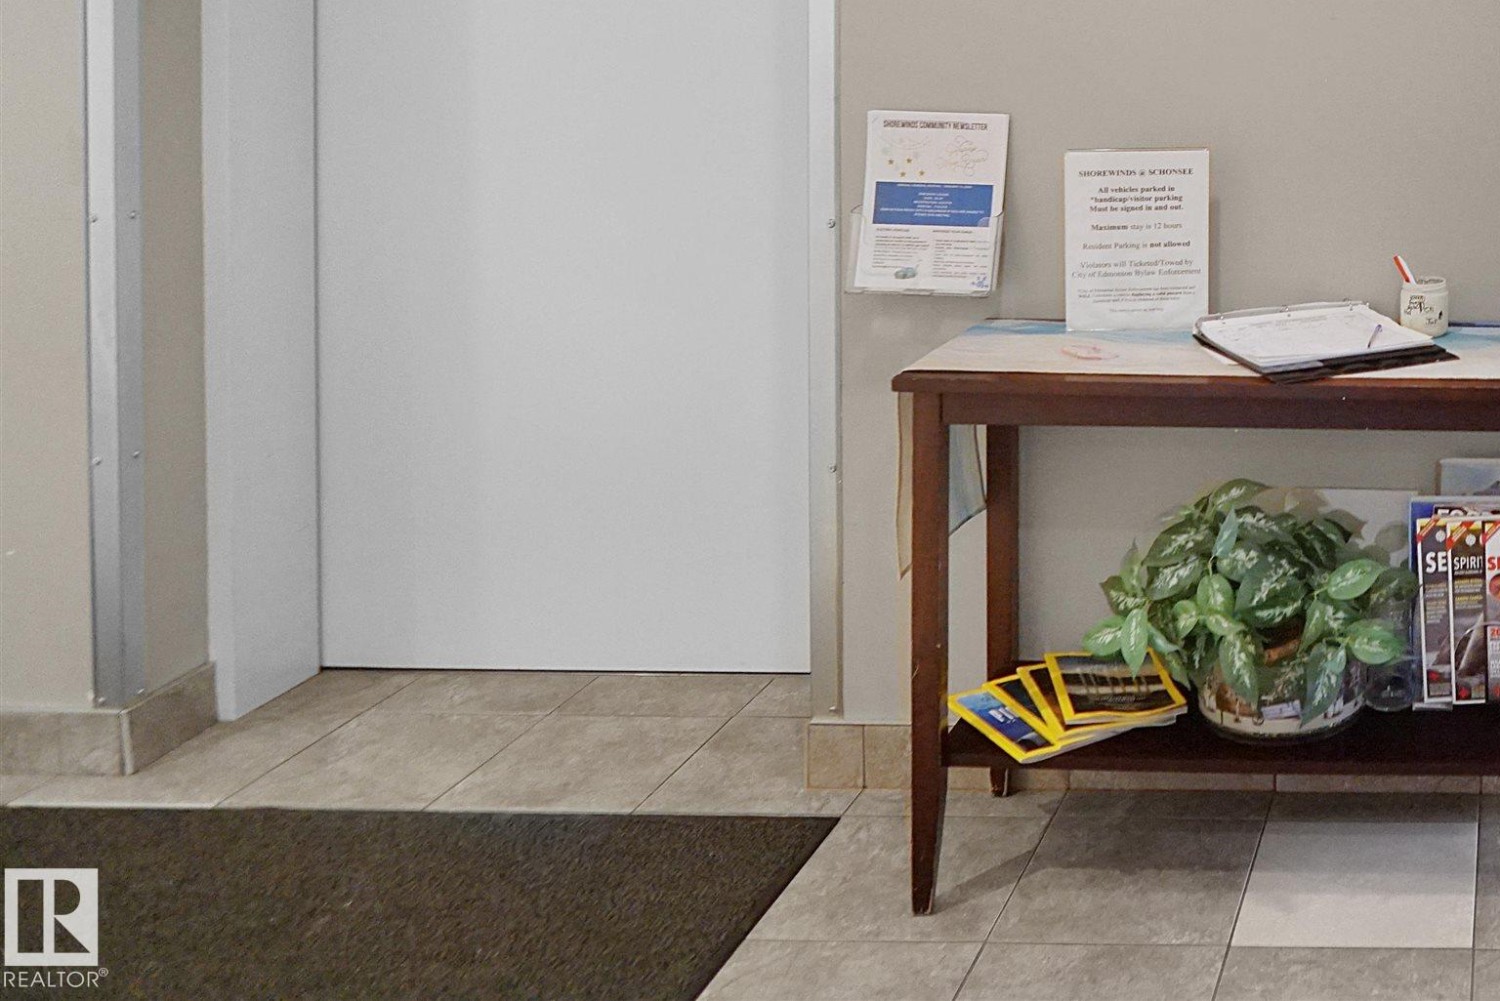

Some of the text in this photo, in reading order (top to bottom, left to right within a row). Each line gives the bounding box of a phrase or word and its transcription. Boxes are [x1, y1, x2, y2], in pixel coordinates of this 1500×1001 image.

[883, 119, 988, 131] SHOREWINDS COMMUNITY NEWSLETTER
[1078, 169, 1137, 177] SHOREWINDS
[1148, 167, 1195, 176] SCHONSEE
[1111, 186, 1139, 194] vehicles
[1140, 185, 1166, 194] parked
[1154, 195, 1183, 203] parking
[1090, 205, 1108, 213] Must
[1120, 204, 1143, 213] signed
[1130, 224, 1143, 232] stay
[1154, 222, 1161, 230] 12
[1163, 222, 1182, 230] hours
[1083, 242, 1112, 250] Resident
[1114, 242, 1140, 250] Parking
[1163, 240, 1191, 248] allowed
[1080, 261, 1112, 269] Violators
[1129, 260, 1183, 268] Ticketed/Towed
[1184, 259, 1193, 268] by
[1071, 267, 1201, 279] City of Edmonton Bylaw Enforcement
